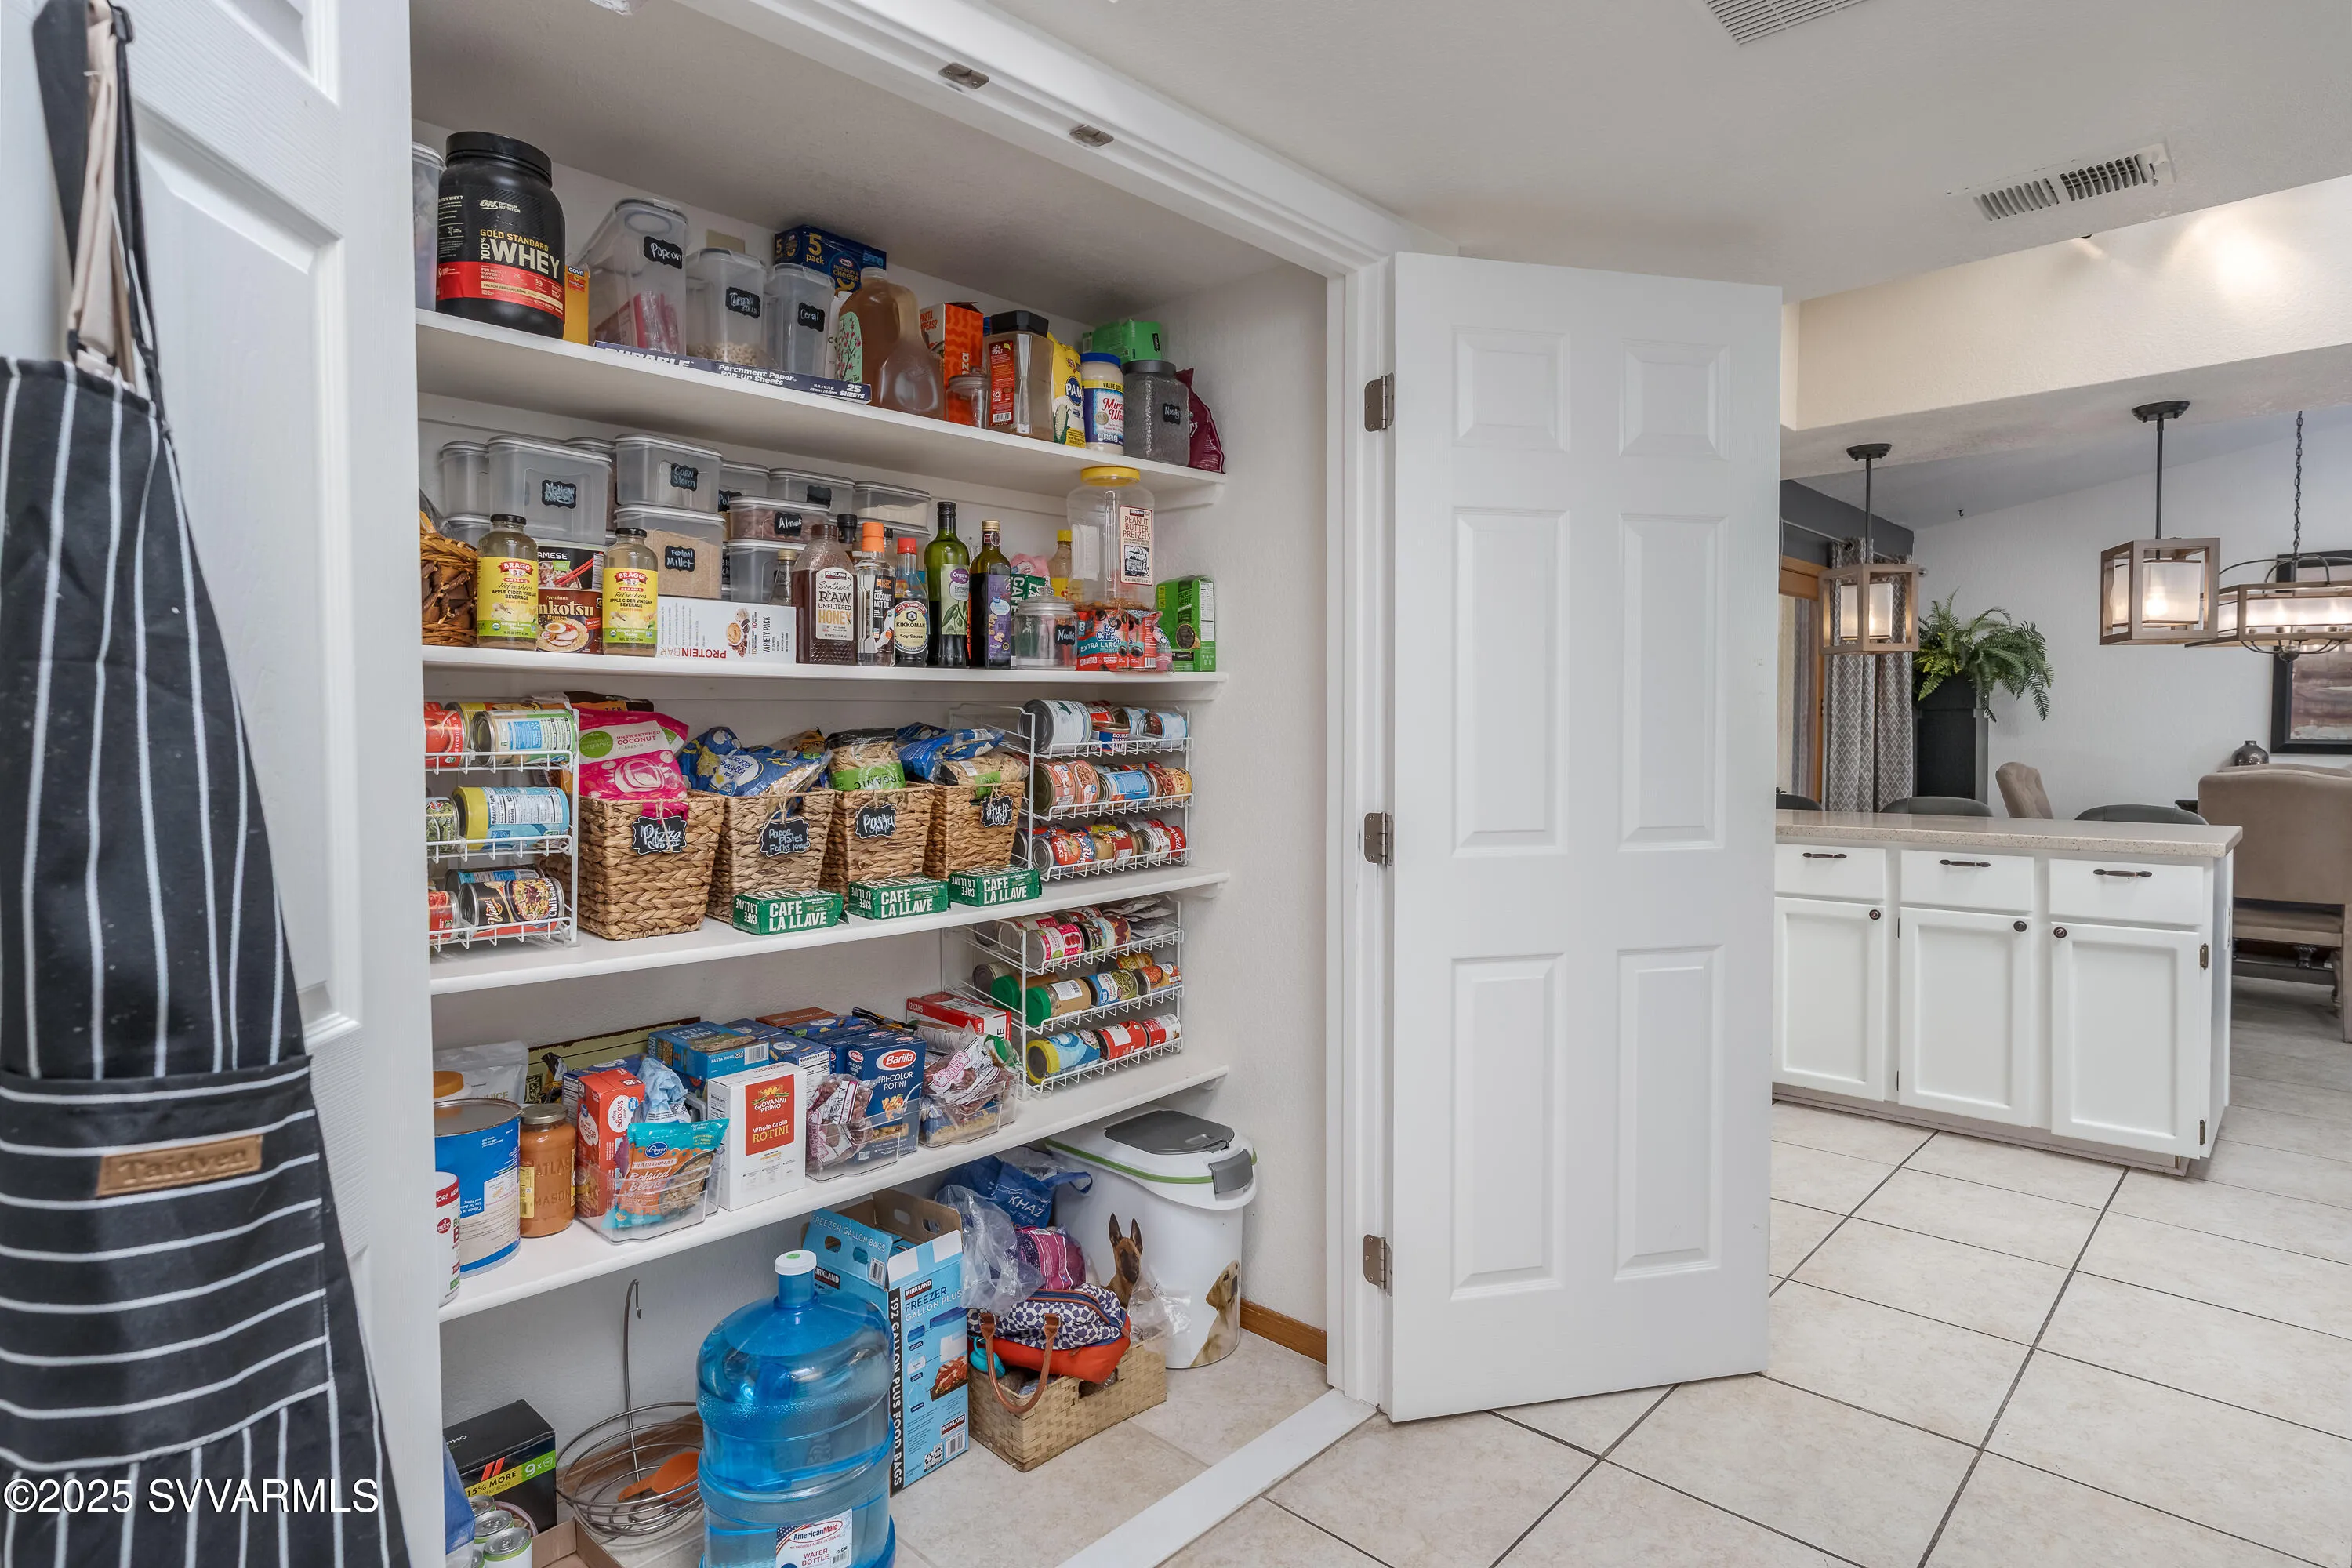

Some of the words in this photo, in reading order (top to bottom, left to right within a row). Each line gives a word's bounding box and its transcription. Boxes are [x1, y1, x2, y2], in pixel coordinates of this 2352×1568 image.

[480, 229, 505, 239] GOLD
[506, 234, 550, 252] STANDARD
[808, 233, 822, 256] 5
[480, 237, 491, 260] 100%
[651, 243, 682, 262] Popcorn
[490, 238, 560, 279] WHEY
[806, 253, 825, 265] pack
[568, 267, 584, 276] GOYA
[718, 364, 768, 376] Parchment
[769, 372, 794, 382] Paper
[753, 375, 784, 386] Sheets
[840, 390, 866, 399] SHEETS
[847, 383, 862, 393] 25
[1124, 515, 1149, 525] PEANUT
[1123, 529, 1151, 540] PRETZELS
[1125, 523, 1149, 533] BUTTER
[503, 562, 531, 571] BRAGG
[666, 557, 695, 568] Millet
[818, 591, 851, 604] RAW
[818, 609, 851, 625] HONEY
[1079, 622, 1085, 631] 8
[1080, 643, 1098, 652] EXTRA
[616, 731, 661, 739] UNSWEETENED
[617, 735, 657, 746] COCONUT
[983, 877, 1008, 891] CAFE
[880, 888, 910, 906] CAFE
[961, 887, 975, 898] CAFE
[983, 889, 996, 905] LA
[1000, 885, 1027, 901] LLAVE
[549, 895, 557, 917] Chili
[769, 900, 803, 918] CAFE
[859, 898, 871, 909] CAFE
[880, 904, 896, 919] LA
[899, 898, 933, 916] LLAVE
[744, 912, 757, 925] CAFE
[769, 916, 789, 931] LA
[789, 912, 826, 928] LLAVE
[672, 1026, 706, 1036] PASTA
[682, 1031, 713, 1041] RONI
[799, 1054, 818, 1063] Nutrition
[886, 1053, 914, 1065] Barilla
[579, 1083, 585, 1093] 50
[884, 1080, 906, 1091] ROTINI
[754, 1097, 787, 1111] GIOVANNI
[760, 1103, 782, 1113] PRIMO
[753, 1123, 771, 1134] Whole
[772, 1120, 788, 1128] Grain
[753, 1125, 789, 1144] ROTINI
[646, 1145, 666, 1155] Kroger
[630, 1168, 672, 1182] Refried
[812, 1214, 842, 1232] FREEZER
[843, 1226, 868, 1243] GALLON
[869, 1237, 887, 1252] BAGS
[906, 1280, 932, 1297] KIRKLAND
[905, 1287, 947, 1313] FREEZER
[905, 1300, 940, 1323] GALLON
[941, 1290, 964, 1306] PLUS
[891, 1297, 899, 1319] 192
[891, 1325, 901, 1372] GALLON
[892, 1377, 901, 1408] PLUS
[942, 1416, 965, 1433] KIRKLAND
[893, 1413, 902, 1453] FOOD
[524, 1463, 536, 1478] 9
[893, 1455, 902, 1486] BAGS
[466, 1484, 487, 1497] 15%
[489, 1471, 517, 1488] MORE
[801, 1553, 829, 1566] BOTTLE
[804, 1548, 828, 1559] WATER
